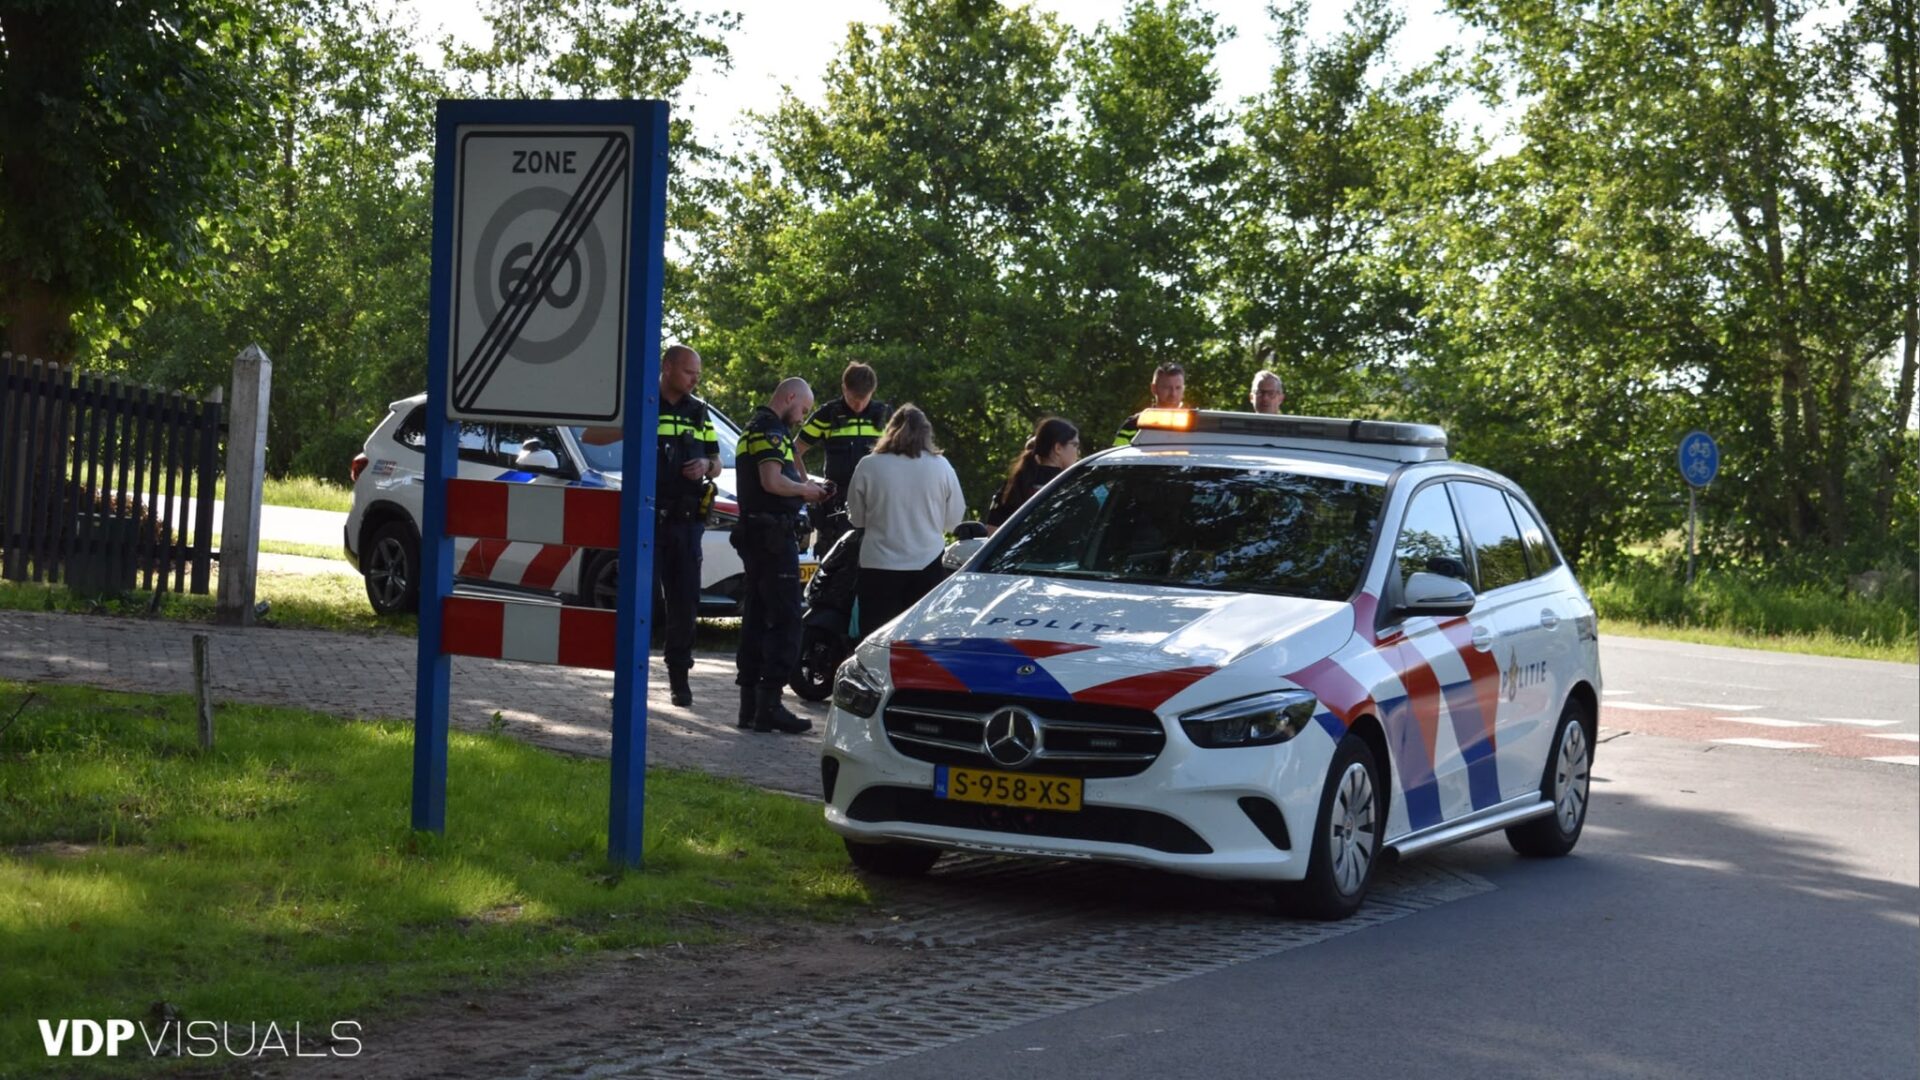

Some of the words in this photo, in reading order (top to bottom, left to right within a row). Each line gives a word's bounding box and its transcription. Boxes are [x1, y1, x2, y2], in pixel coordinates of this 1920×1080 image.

[512, 151, 576, 174] ZONE
[498, 242, 582, 309] 60
[986, 617, 1144, 633] POLIT
[954, 771, 1071, 805] S-958-XS
